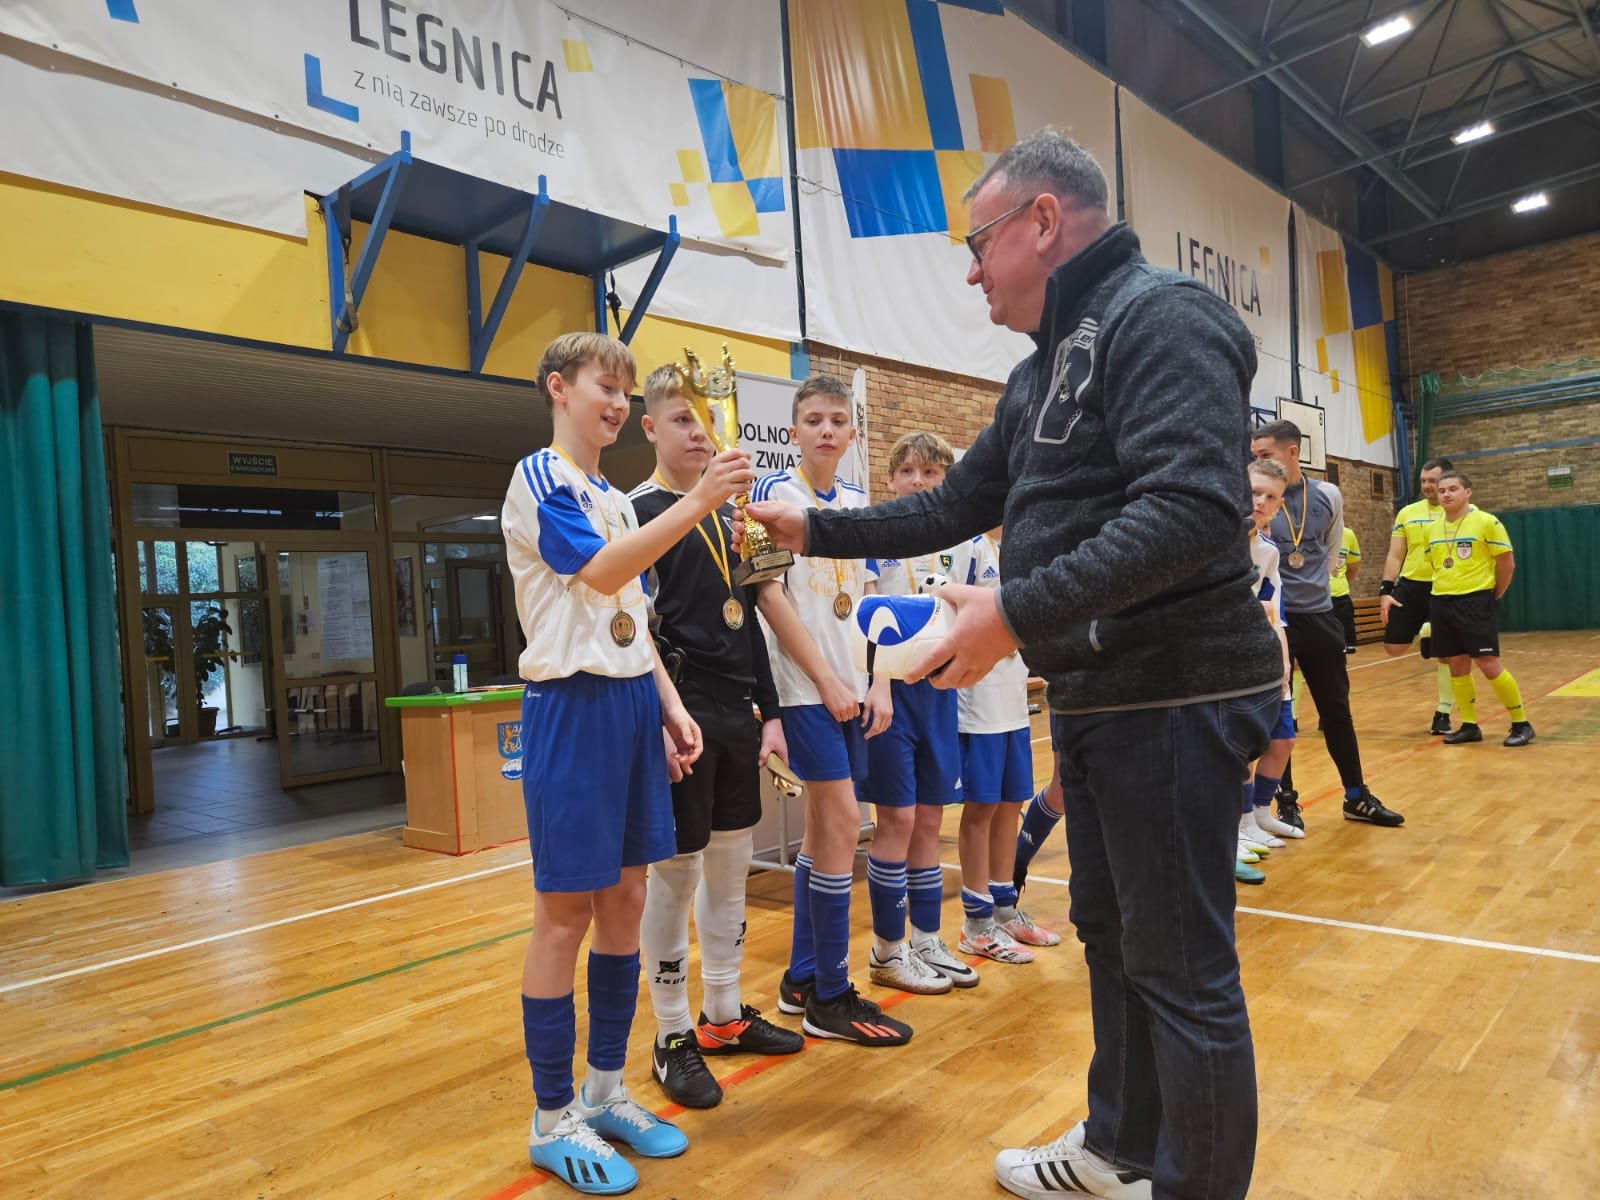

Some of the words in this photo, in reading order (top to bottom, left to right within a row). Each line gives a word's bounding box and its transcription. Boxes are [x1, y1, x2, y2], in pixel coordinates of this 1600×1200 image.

[350, 0, 562, 119] LEGNICA
[354, 70, 366, 89] z
[372, 75, 405, 107] nią
[409, 90, 478, 128] zawsze
[485, 115, 506, 137] po
[512, 121, 565, 158] drodze
[232, 455, 273, 466] WYJŚCIE
